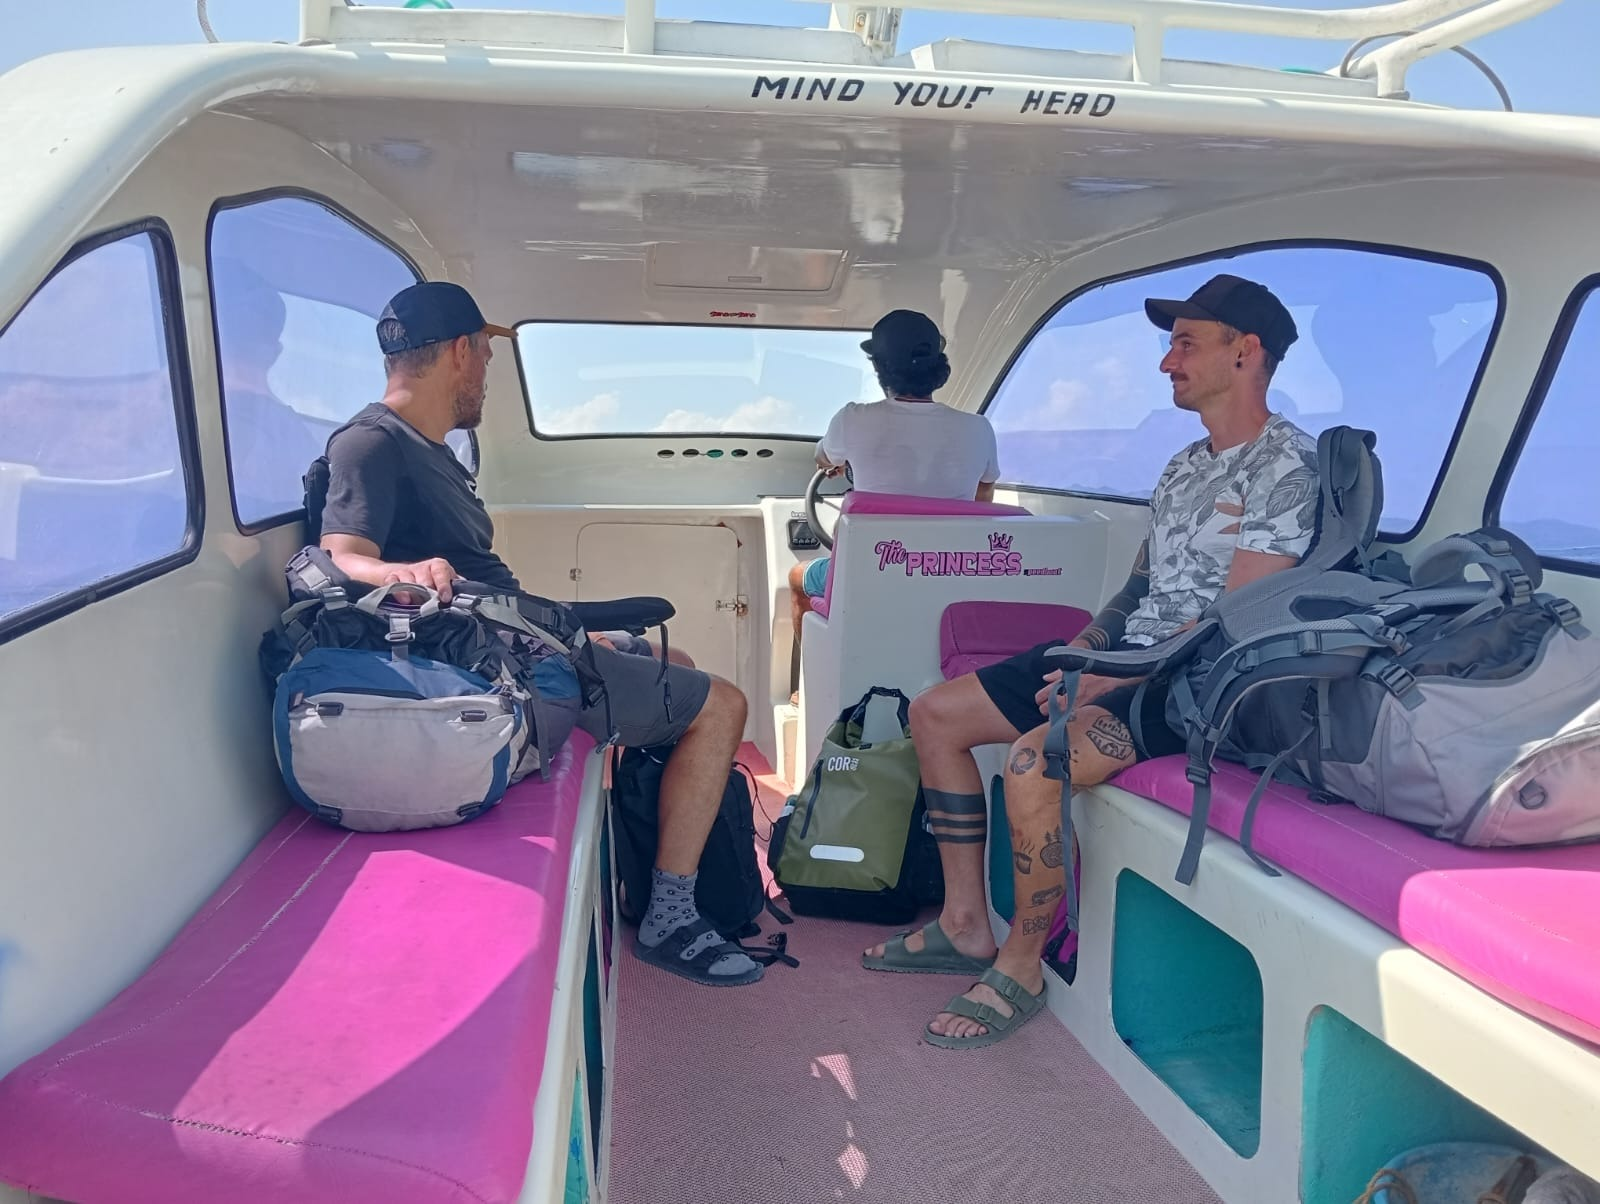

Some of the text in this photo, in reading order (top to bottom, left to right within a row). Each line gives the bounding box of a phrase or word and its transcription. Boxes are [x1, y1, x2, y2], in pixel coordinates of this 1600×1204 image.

[751, 76, 865, 102] MIND
[1020, 90, 1116, 118] HEAD
[874, 540, 907, 572] The
[906, 551, 1023, 577] PRINCESS
[827, 756, 851, 772] COR
